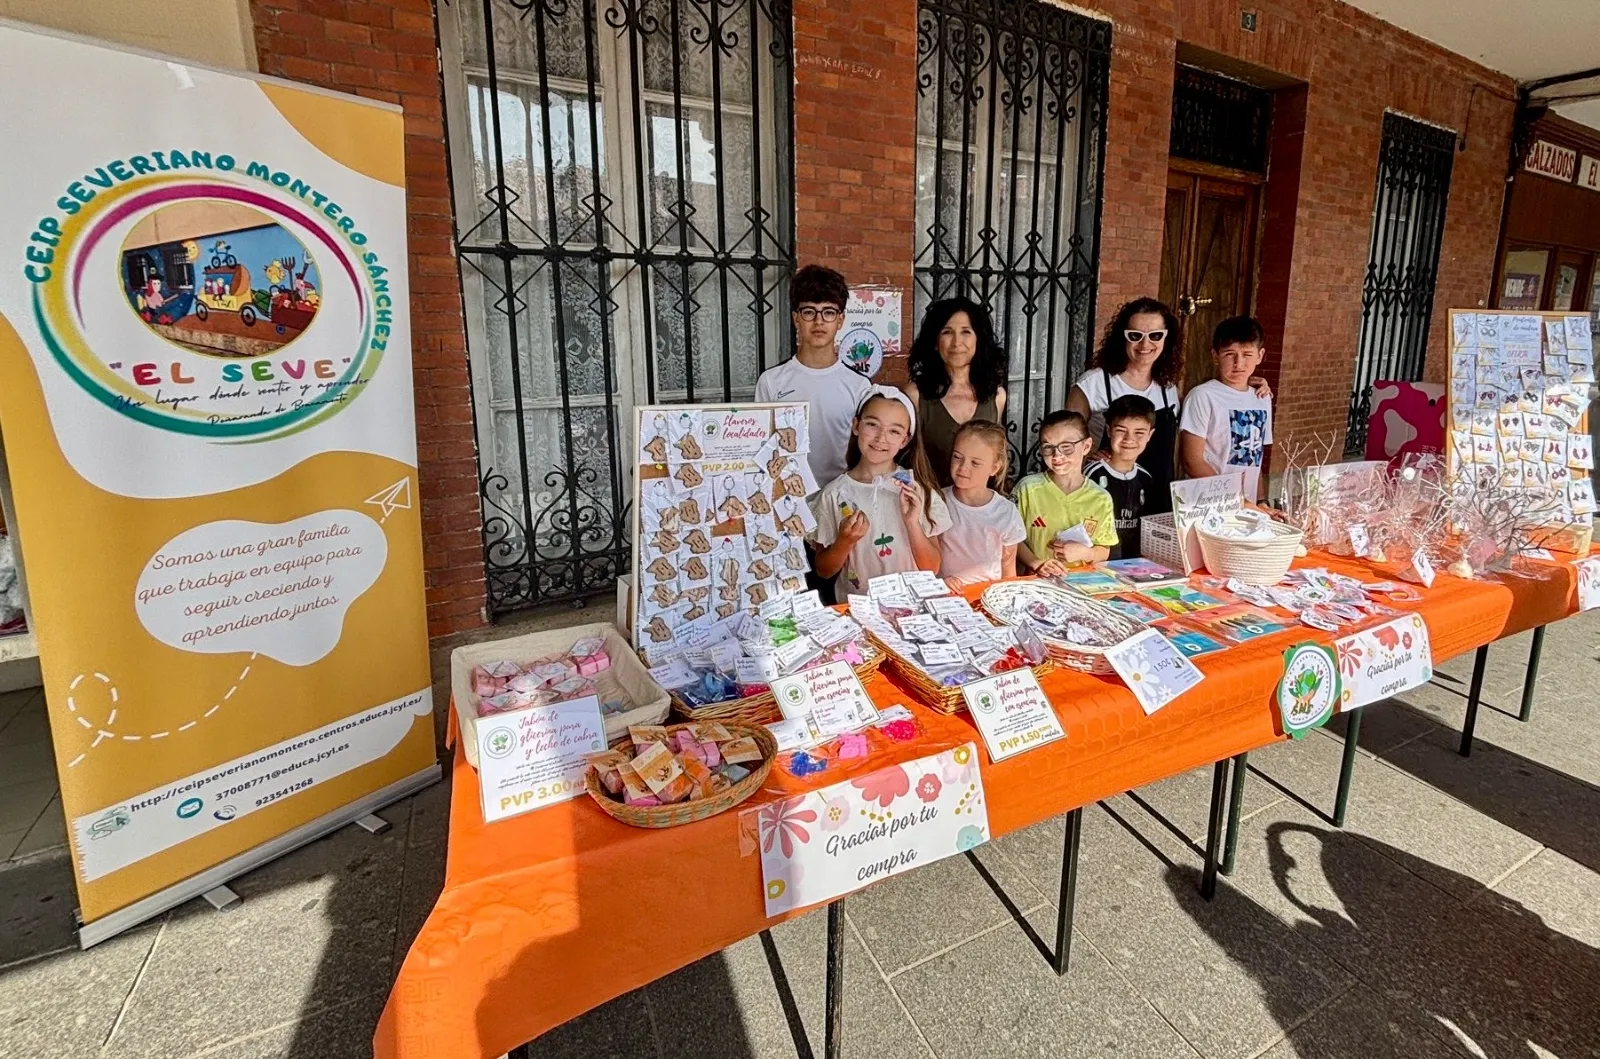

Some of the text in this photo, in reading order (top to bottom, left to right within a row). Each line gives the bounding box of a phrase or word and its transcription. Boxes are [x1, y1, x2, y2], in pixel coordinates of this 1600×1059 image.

[1587, 161, 1599, 187] EL
[25, 148, 394, 352] CEIP SEVERIANO MONTERO SÁNCHEZ
[847, 307, 864, 315] racias
[155, 389, 200, 411] lugar
[257, 380, 292, 396] sentir
[300, 384, 312, 396] y
[317, 373, 370, 392] aprender
[275, 403, 287, 413] de
[722, 427, 767, 440] localidades
[702, 464, 722, 473] PVP
[724, 462, 745, 471] 2.00
[152, 523, 352, 571] Somos una gran familia
[138, 545, 363, 605] que trabaja en equipo para
[183, 573, 335, 619] seguir creciendo y
[181, 595, 340, 646] aprendiendo juntos
[824, 667, 834, 676] de
[1366, 651, 1413, 679] Gracias por tu
[809, 674, 854, 697] glicerina para
[1012, 674, 1020, 684] de
[1380, 678, 1408, 696] compra
[814, 687, 851, 704] con esencias
[999, 684, 1039, 705] glicerina para
[1004, 698, 1038, 713] con esencias
[518, 710, 560, 730] Jabón de
[519, 722, 582, 747] glicerina para
[525, 728, 599, 760] y leche de cabra
[999, 736, 1020, 752] PVP
[1020, 729, 1041, 744] 1.50
[130, 695, 423, 813] http://ceipseverianomontero.centros.educa.jcyl.es/
[215, 742, 350, 802] 37008771@educa.jcyl.es
[255, 777, 314, 808] 923541268
[500, 779, 572, 811] PVP 3.00
[825, 805, 939, 857] Gracias por tu
[857, 848, 918, 881] compra
